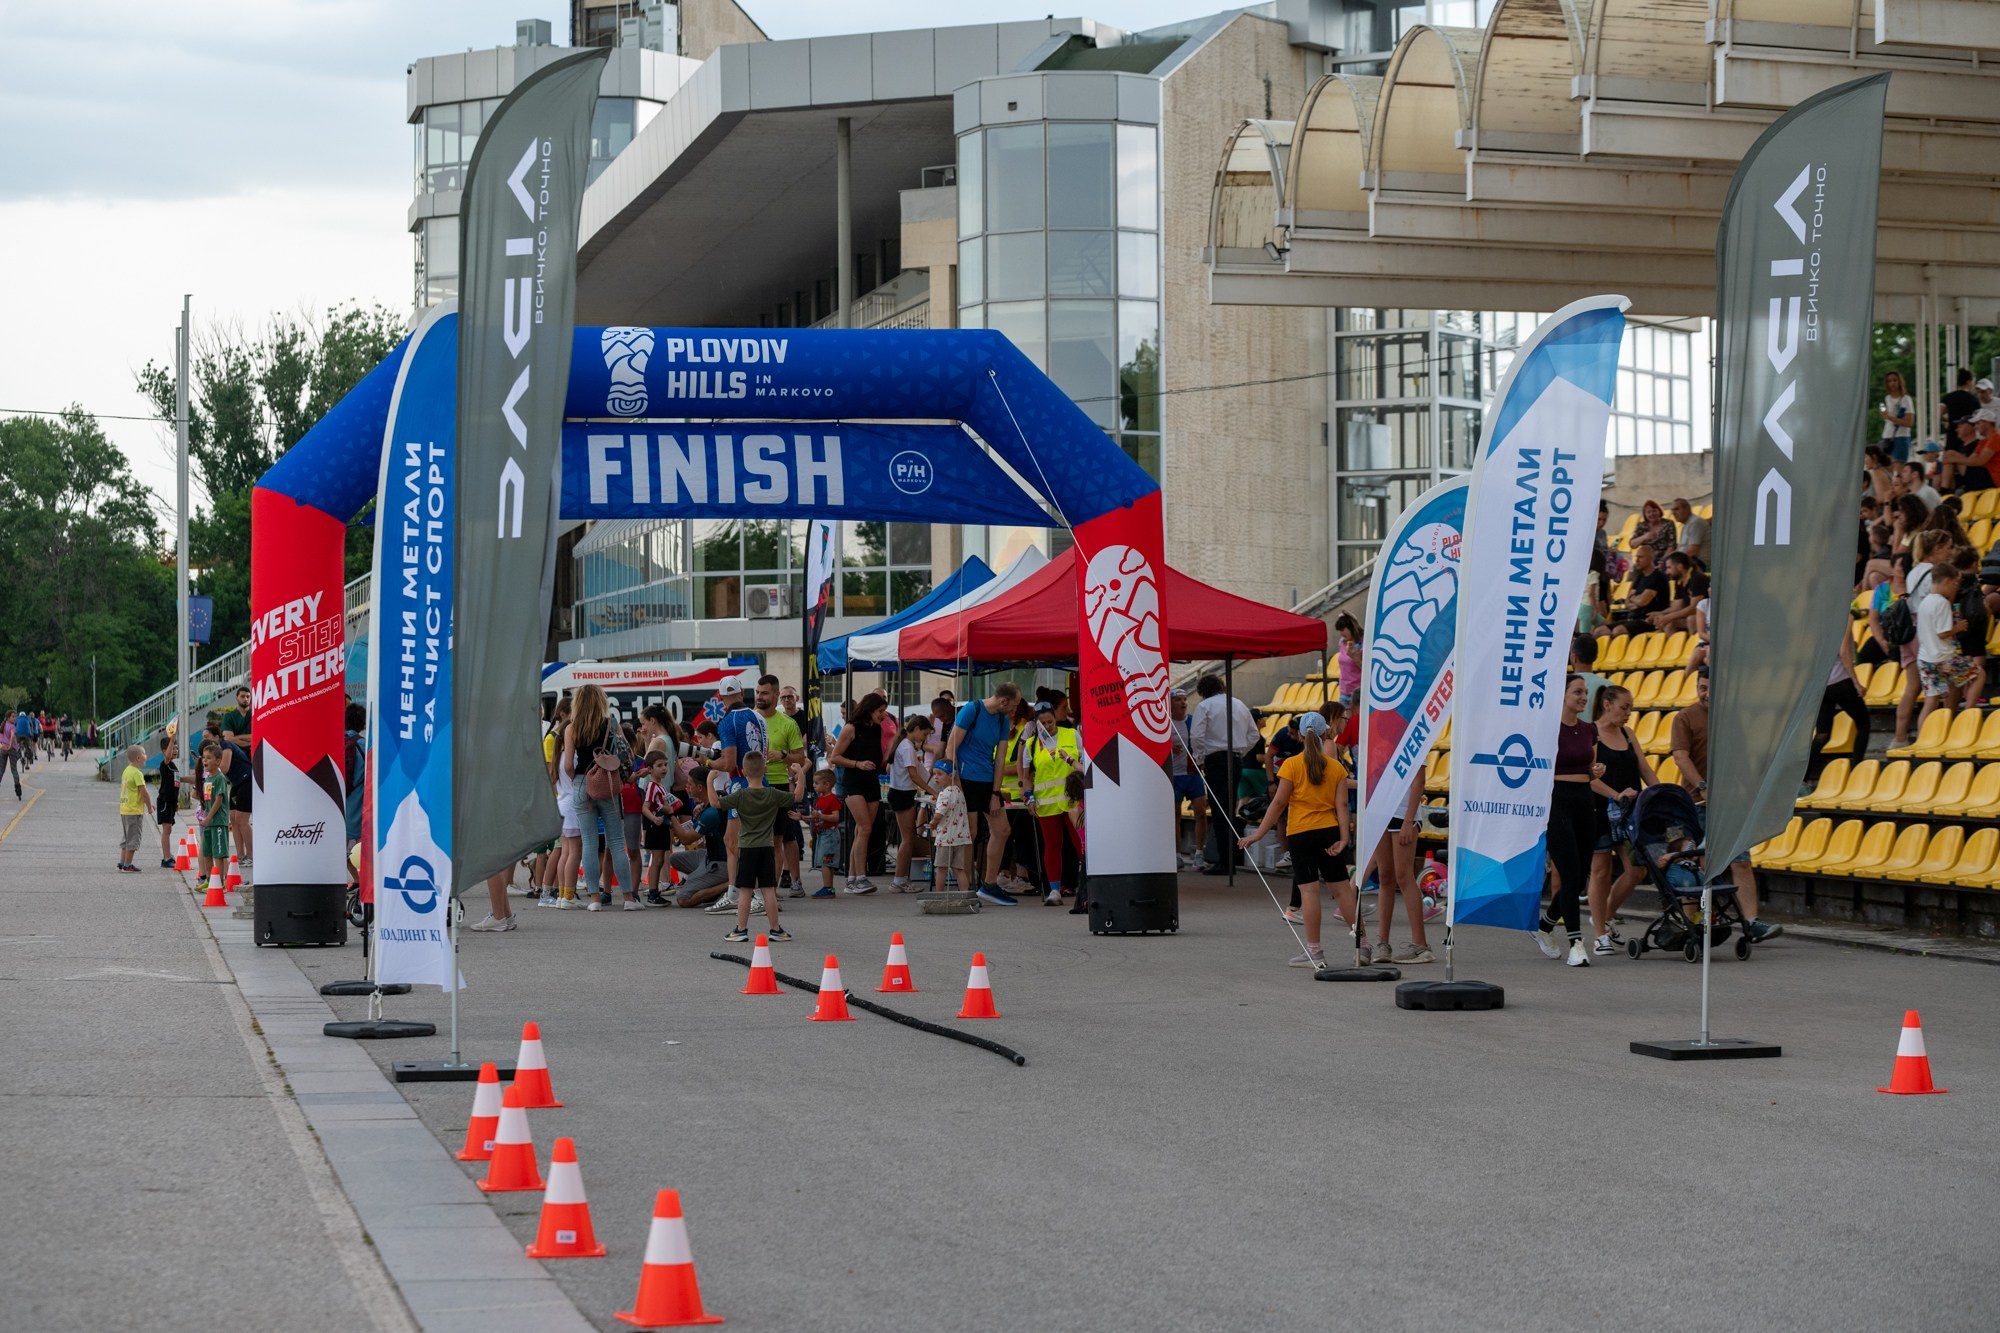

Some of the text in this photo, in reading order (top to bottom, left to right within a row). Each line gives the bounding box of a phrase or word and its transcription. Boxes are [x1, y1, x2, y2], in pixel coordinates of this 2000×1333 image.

[535, 136, 552, 323] ВСИЧКО. ТОЧНО.
[1806, 162, 1827, 341] ВСИЧКО. ТОЧНО.
[667, 338, 788, 364] PLOVDIV
[667, 371, 772, 399] HILLS IN
[755, 388, 834, 397] MARKOVO
[587, 434, 845, 506] FINISH
[896, 463, 926, 478] P/H
[400, 442, 422, 740] ЦЕННИ МЕТАЛИ
[424, 441, 445, 744] ЗА ЧИСТ СПОРТ
[1500, 447, 1542, 706] ЦЕННИ МЕТАЛИ
[1529, 447, 1576, 709] ЗА ЧИСТ СПОРТ
[251, 590, 324, 655] EVERY
[279, 613, 341, 666] STEP
[251, 641, 344, 717] MATTERS
[572, 669, 669, 679] ТРАНСПОРТ С ЛИНЕЙКА
[1090, 680, 1125, 697] PLOVDIV
[1097, 694, 1121, 708] HILLS
[1394, 669, 1455, 780] EVERY STEP
[1464, 801, 1511, 815] ХОЛДИНГ
[1512, 803, 1535, 819] КЦМ
